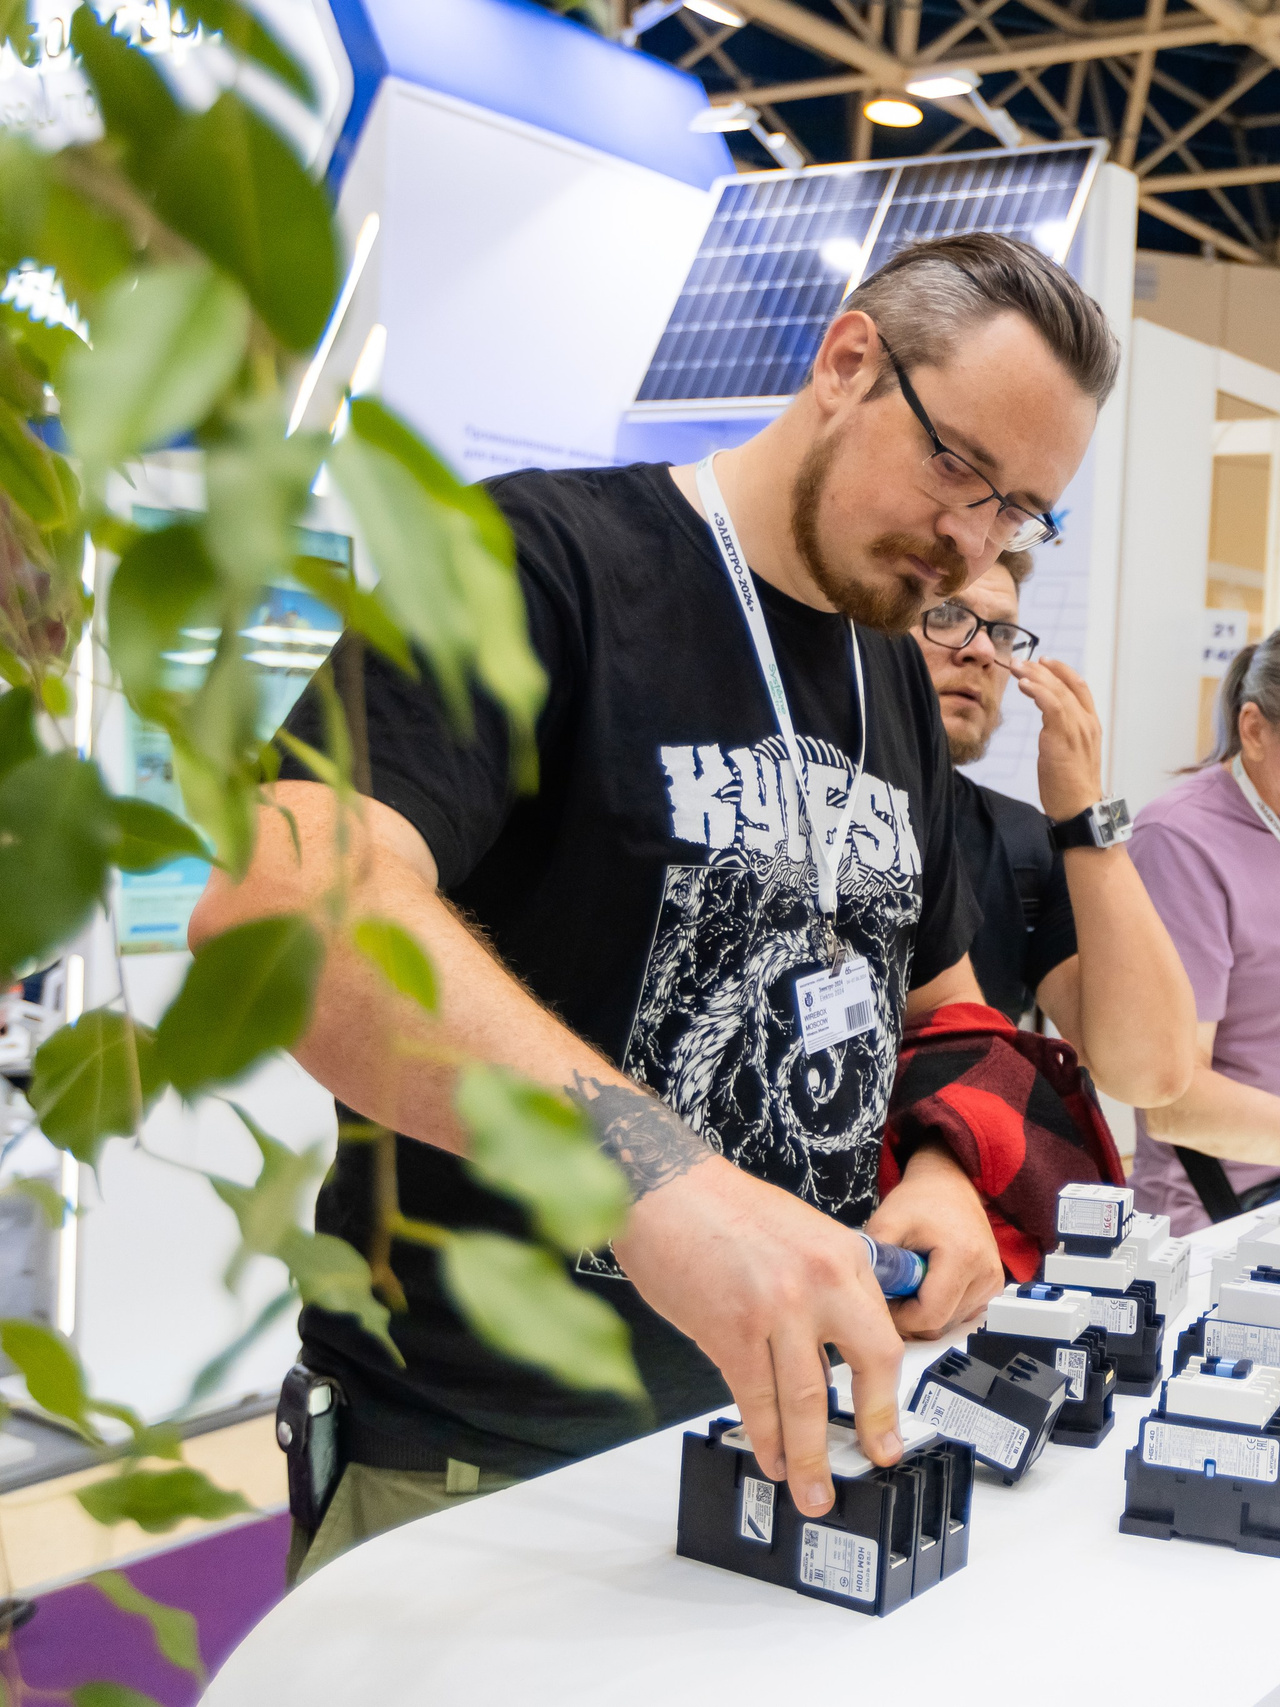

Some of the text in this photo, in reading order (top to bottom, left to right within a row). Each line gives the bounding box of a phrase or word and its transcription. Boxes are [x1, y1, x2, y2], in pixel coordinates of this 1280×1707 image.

[712, 511, 755, 613] «ЭЛЕКТРО-2024»
[804, 1009, 827, 1021] WIREBOX
[806, 1018, 828, 1030] MOSCOW
[1206, 1336, 1212, 1346] 50
[920, 1395, 931, 1416] HYUNDAI
[1017, 1429, 1027, 1445] HGT
[1150, 1430, 1156, 1441] 40
[1247, 1438, 1256, 1450] CE
[1257, 1439, 1267, 1451] EAC
[814, 1568, 824, 1581] EAC
[856, 1546, 865, 1593] HGM100H
